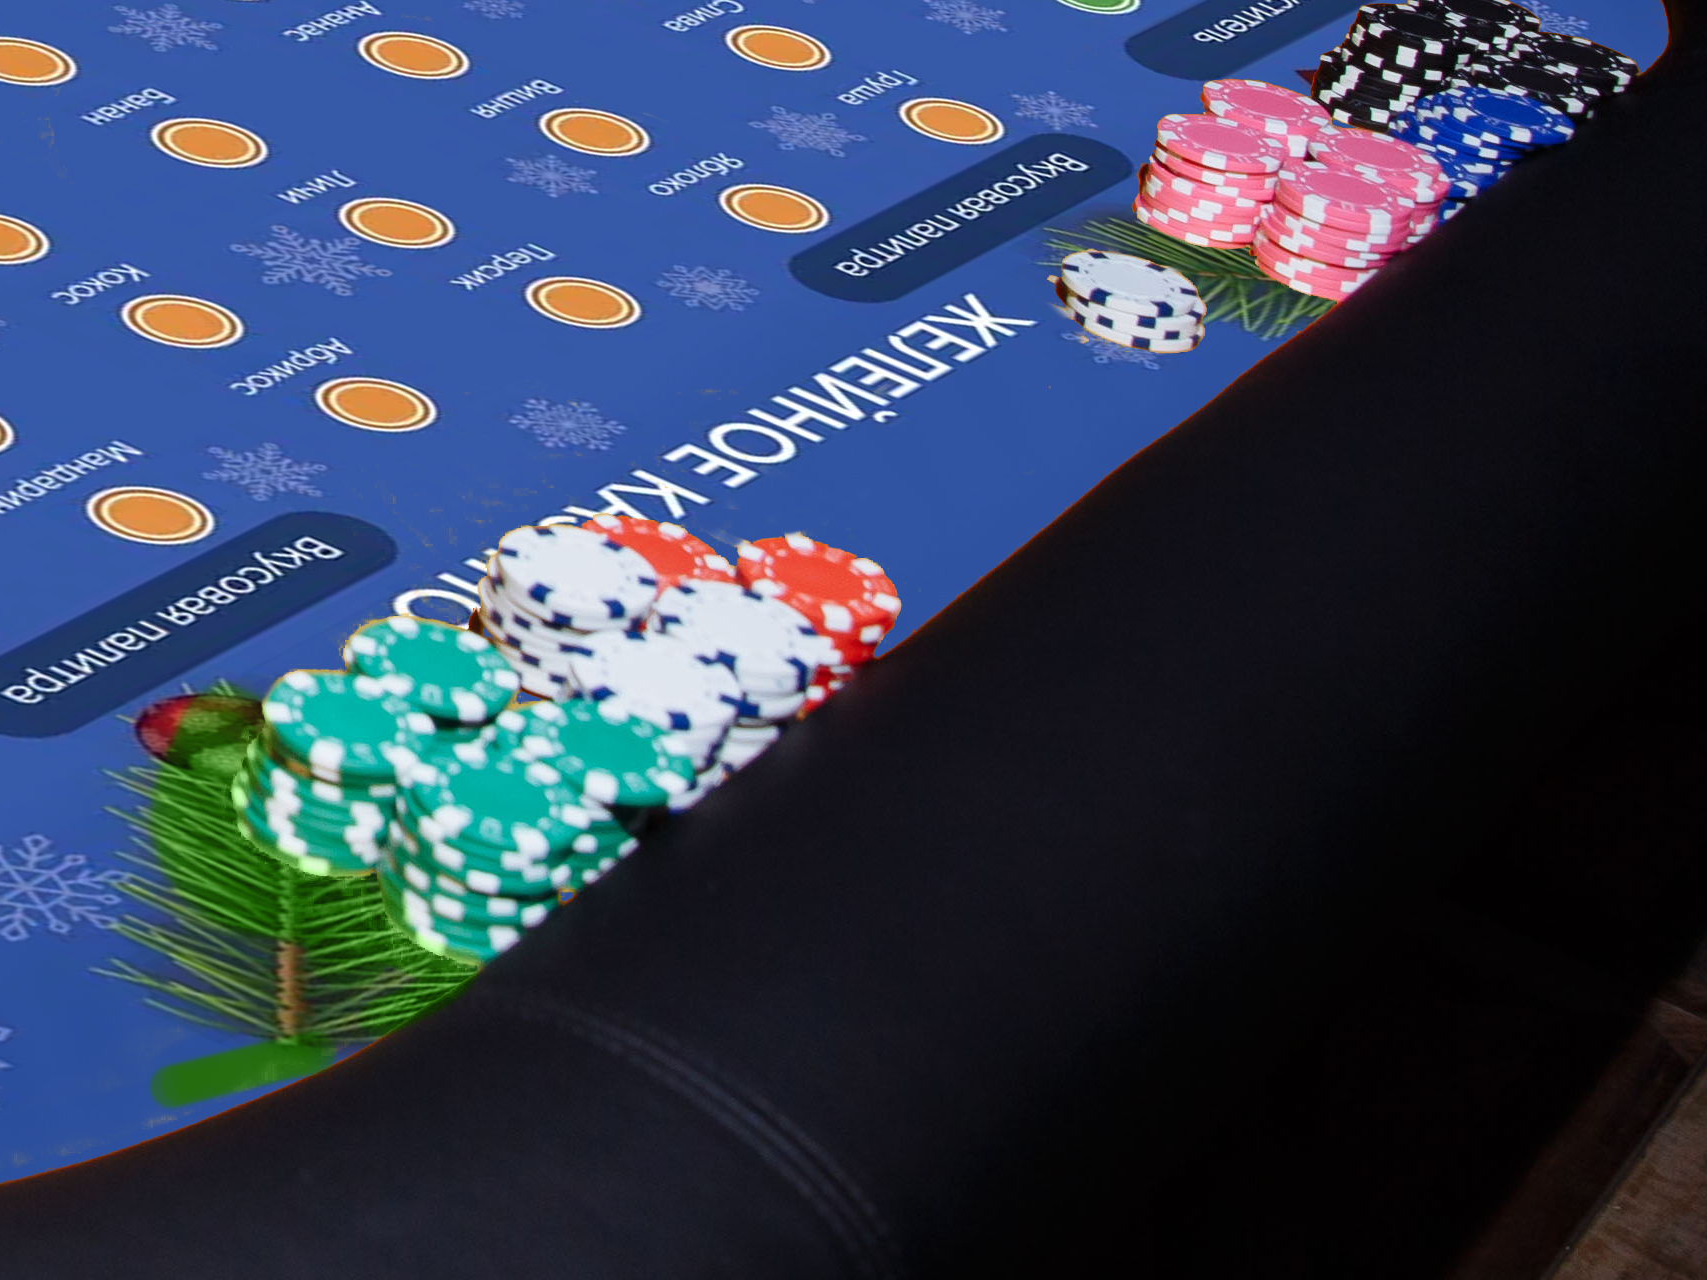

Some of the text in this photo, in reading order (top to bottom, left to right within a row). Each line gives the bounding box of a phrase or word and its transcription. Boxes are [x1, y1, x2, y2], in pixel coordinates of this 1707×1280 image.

[283, 0, 382, 42] Ананас
[81, 88, 176, 125] Банан
[470, 79, 564, 119] Вишня
[837, 70, 918, 105] Груша
[277, 169, 357, 204] Личи
[648, 152, 744, 196] Яблоко
[834, 153, 1089, 279] Вкусовая палитра
[51, 263, 150, 305] Кокос
[449, 243, 556, 291] Персик
[229, 337, 353, 396] Абрикос
[663, 293, 1034, 488] ЖЕЛЕЙНОЕ
[1, 536, 343, 705] Вкусовая палитра
